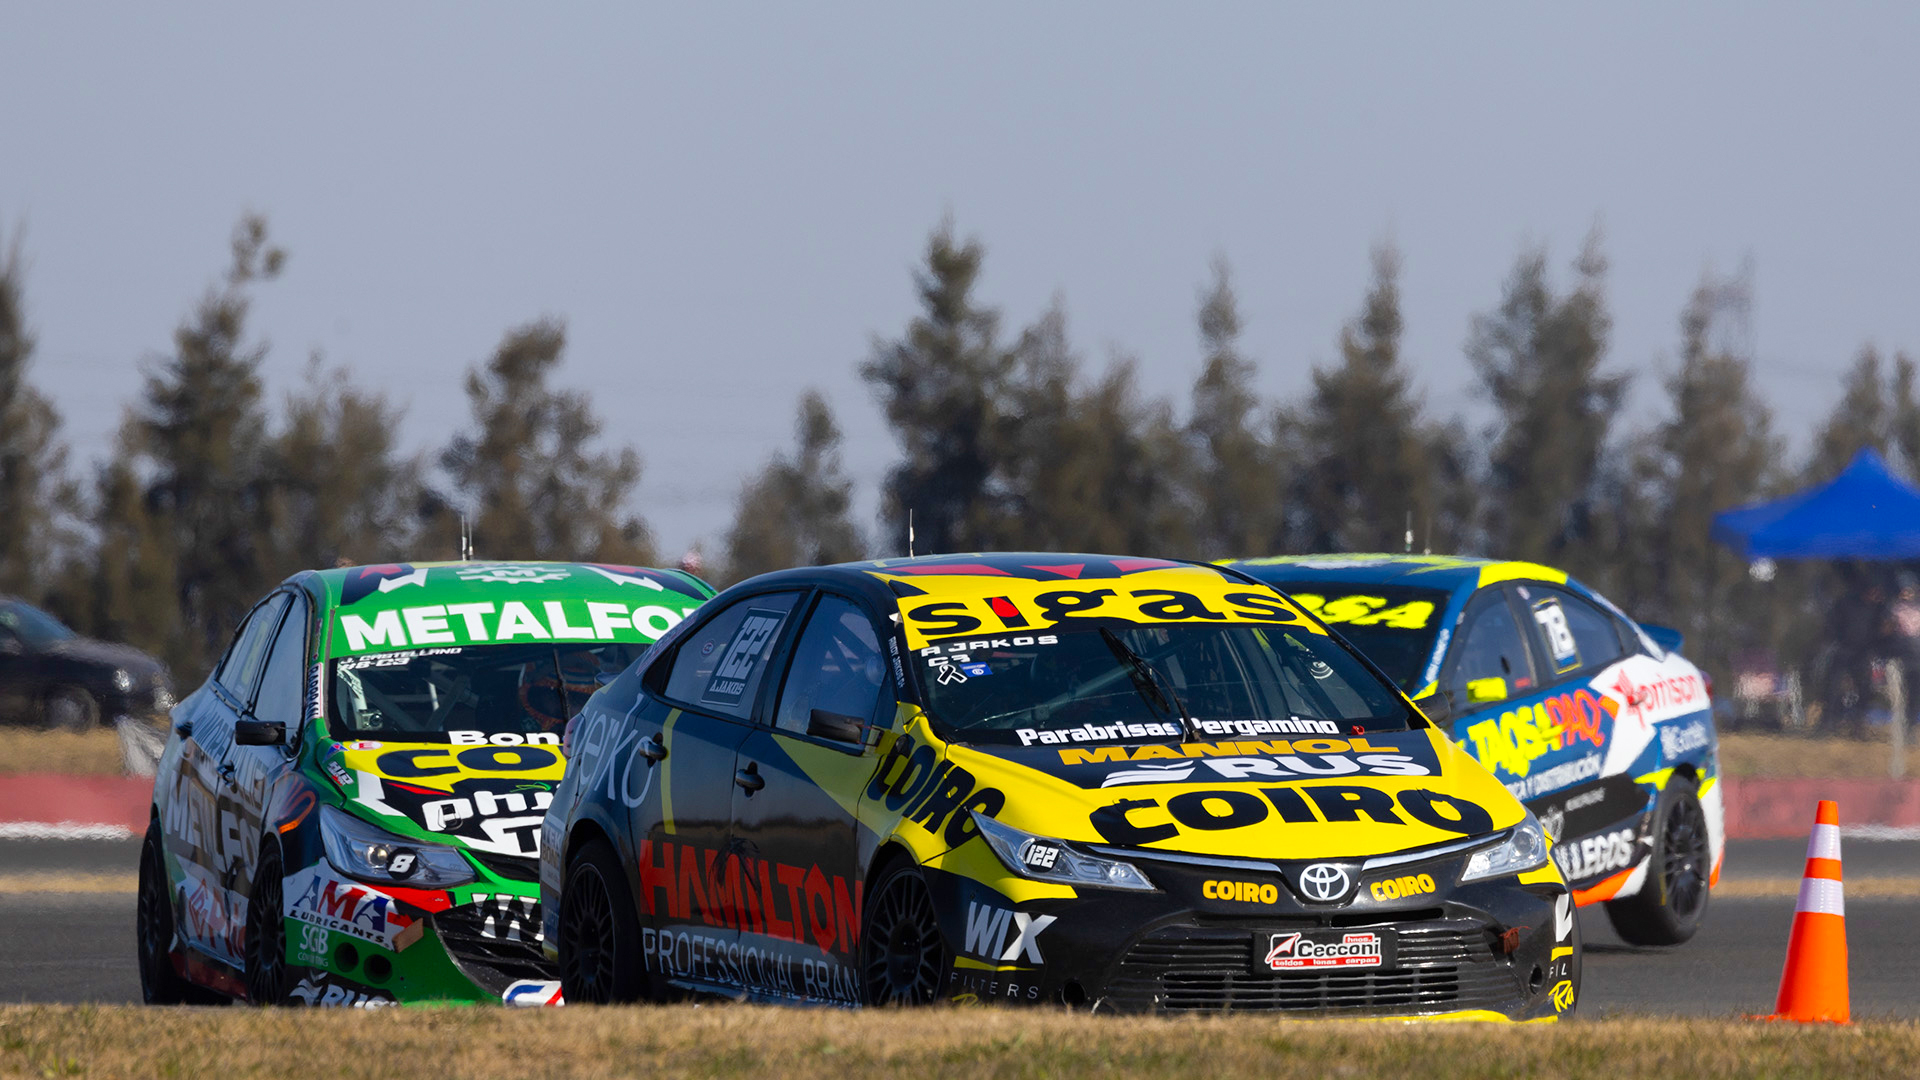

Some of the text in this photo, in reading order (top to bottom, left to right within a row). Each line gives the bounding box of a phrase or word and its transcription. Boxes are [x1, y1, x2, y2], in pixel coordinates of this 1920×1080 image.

[340, 601, 698, 652] METALFO
[908, 588, 1298, 636] sigas
[715, 615, 780, 680] 122
[920, 635, 1059, 657] A JAKOS
[1016, 717, 1340, 746] Parabrisas Pergamino
[1057, 737, 1400, 766] MANNOL
[1201, 754, 1431, 779] RUS
[867, 734, 1006, 850] COIRO
[1088, 785, 1495, 846] COIRO
[388, 852, 415, 873] 8
[1024, 844, 1060, 868] 122
[639, 838, 863, 957] HAMILTON
[1202, 880, 1279, 904] COIRO
[1369, 873, 1436, 902] COIRO
[293, 874, 390, 934] AMA
[289, 909, 385, 944] LUBRICANTS
[965, 901, 1058, 965] WIX
[642, 927, 796, 989] PROFESSIONAL
[1297, 939, 1380, 958] Cecconi
[1345, 957, 1377, 966] carpas
[950, 972, 1039, 1000] FILTERS
